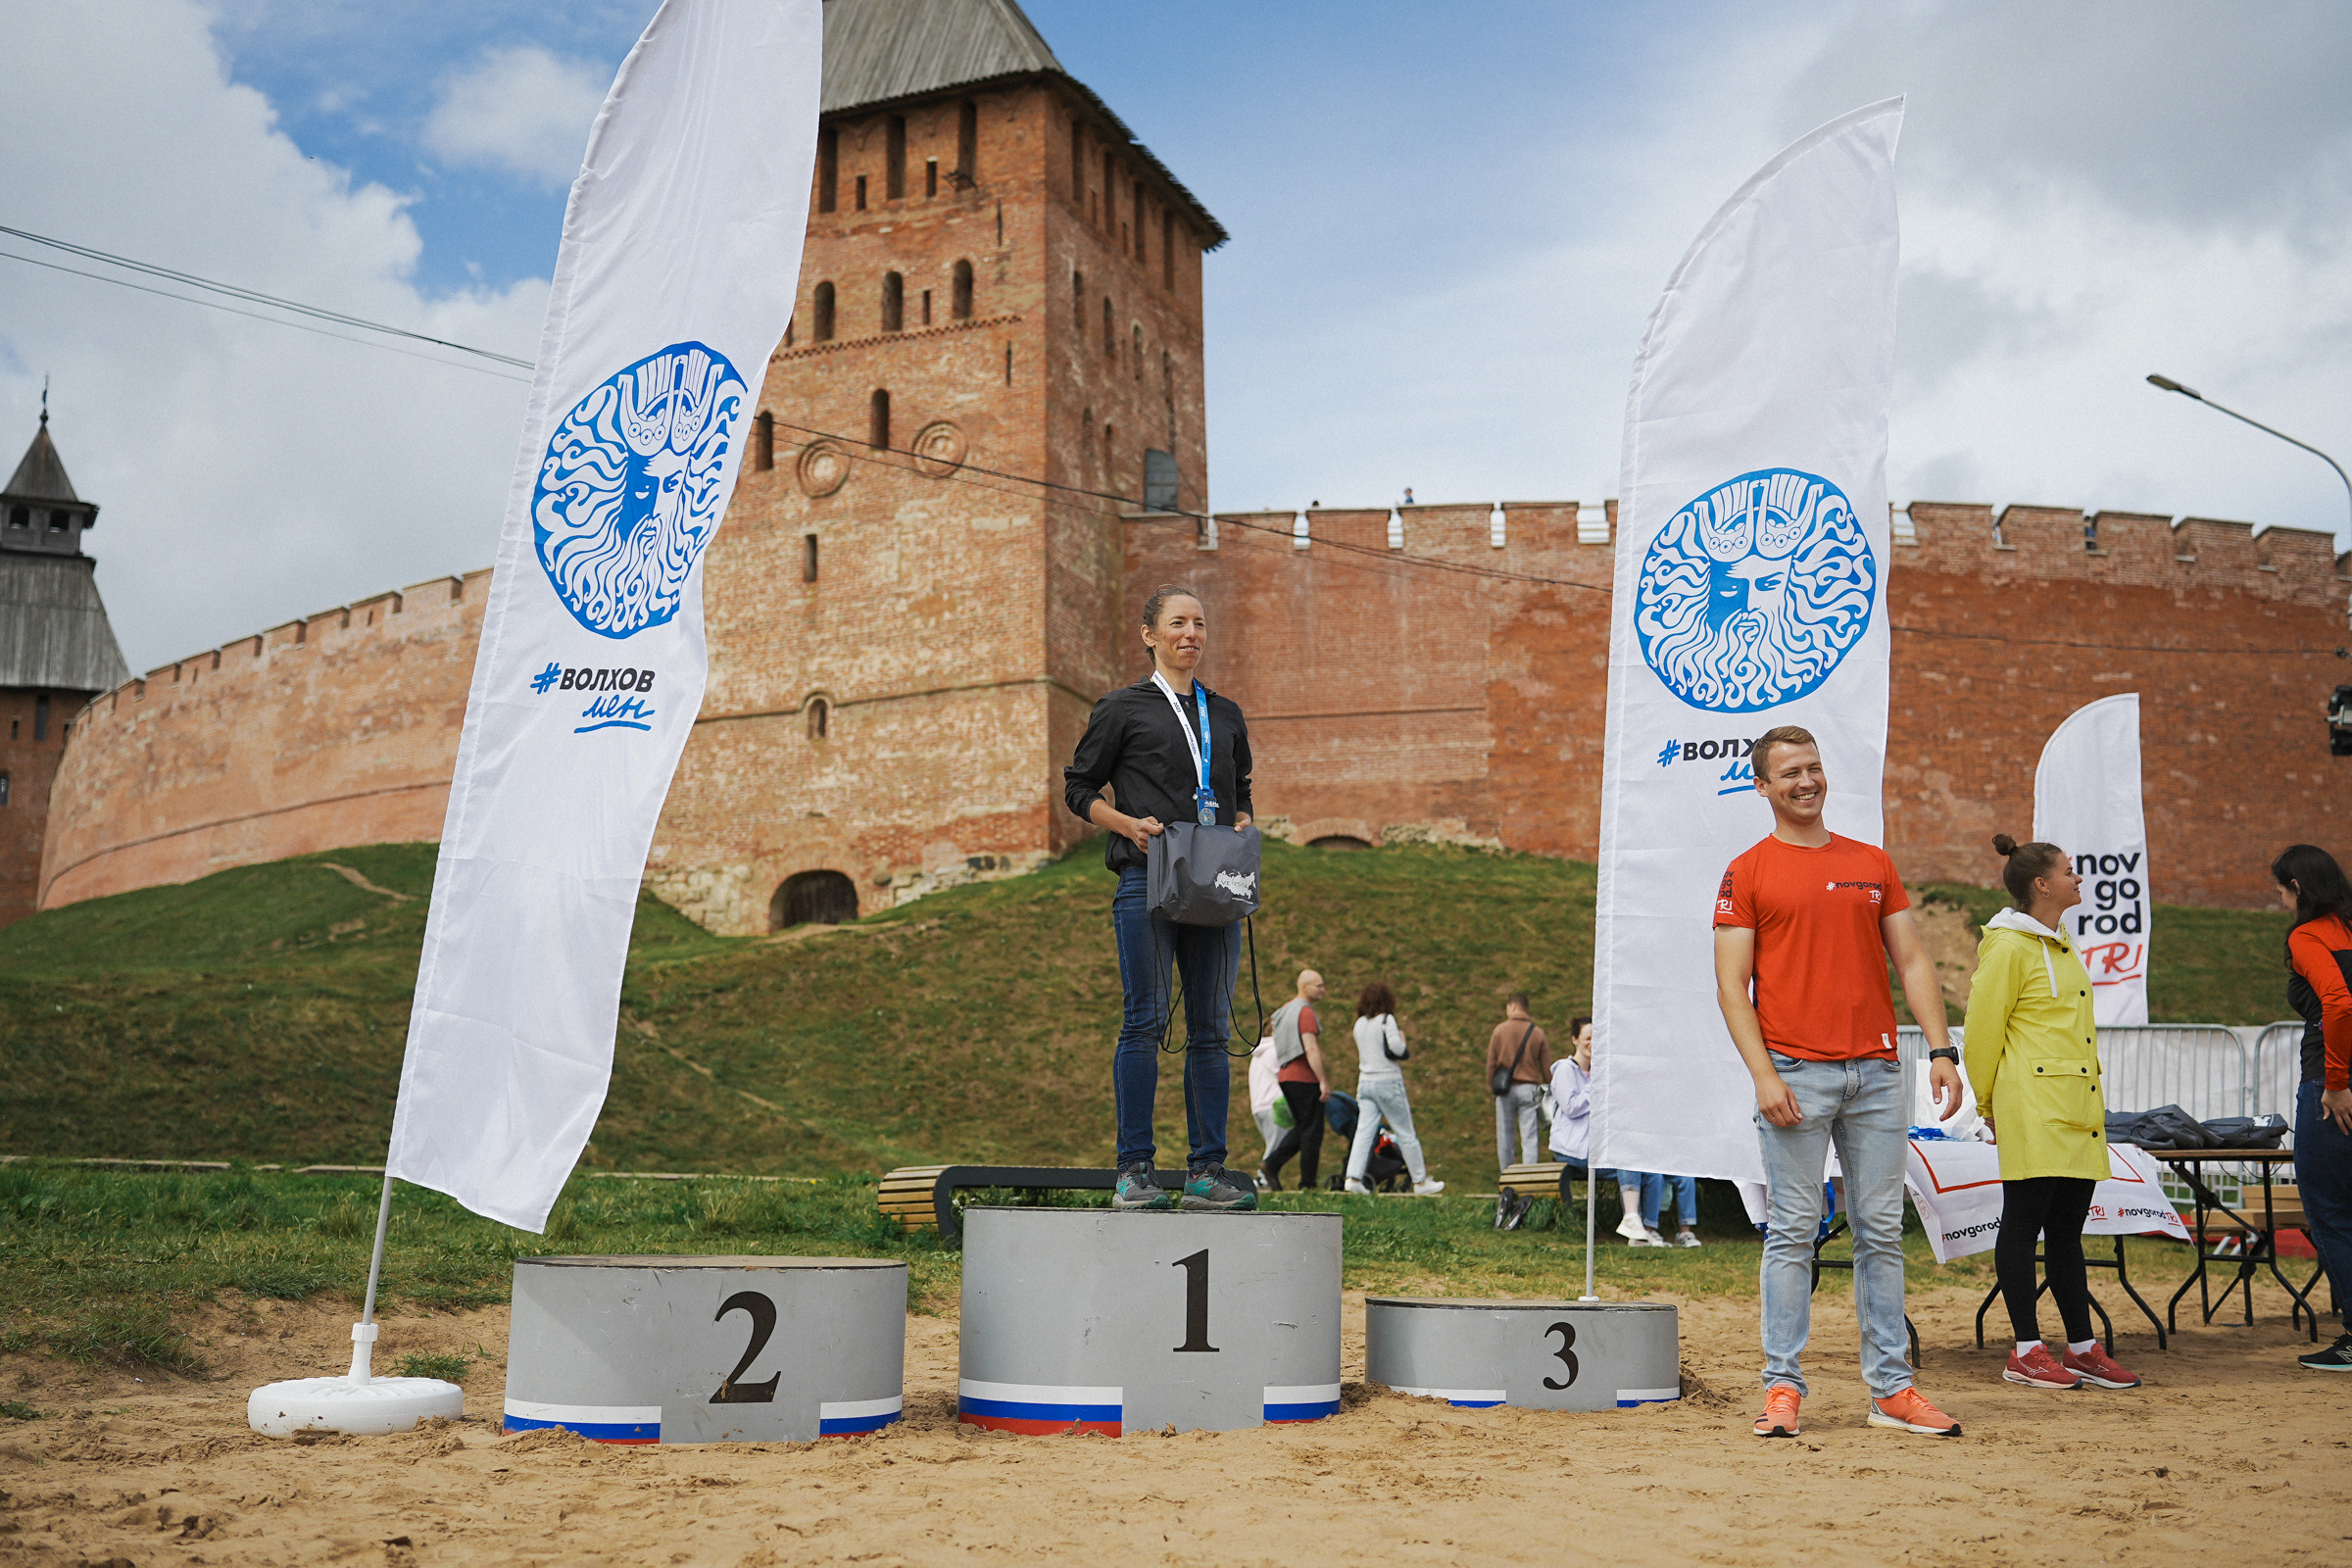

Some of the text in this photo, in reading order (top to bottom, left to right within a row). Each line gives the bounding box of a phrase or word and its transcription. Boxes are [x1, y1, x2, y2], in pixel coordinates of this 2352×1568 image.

[530, 662, 656, 695] #ВОЛХОВ
[1657, 738, 1760, 767] #ВОЛХ
[2067, 853, 2141, 875] nov
[1719, 887, 1733, 899] od
[2095, 878, 2140, 910] go
[2078, 901, 2142, 936] rod
[1171, 1248, 1220, 1353] 1
[709, 1291, 782, 1404] 2
[1543, 1321, 1580, 1391] 3
